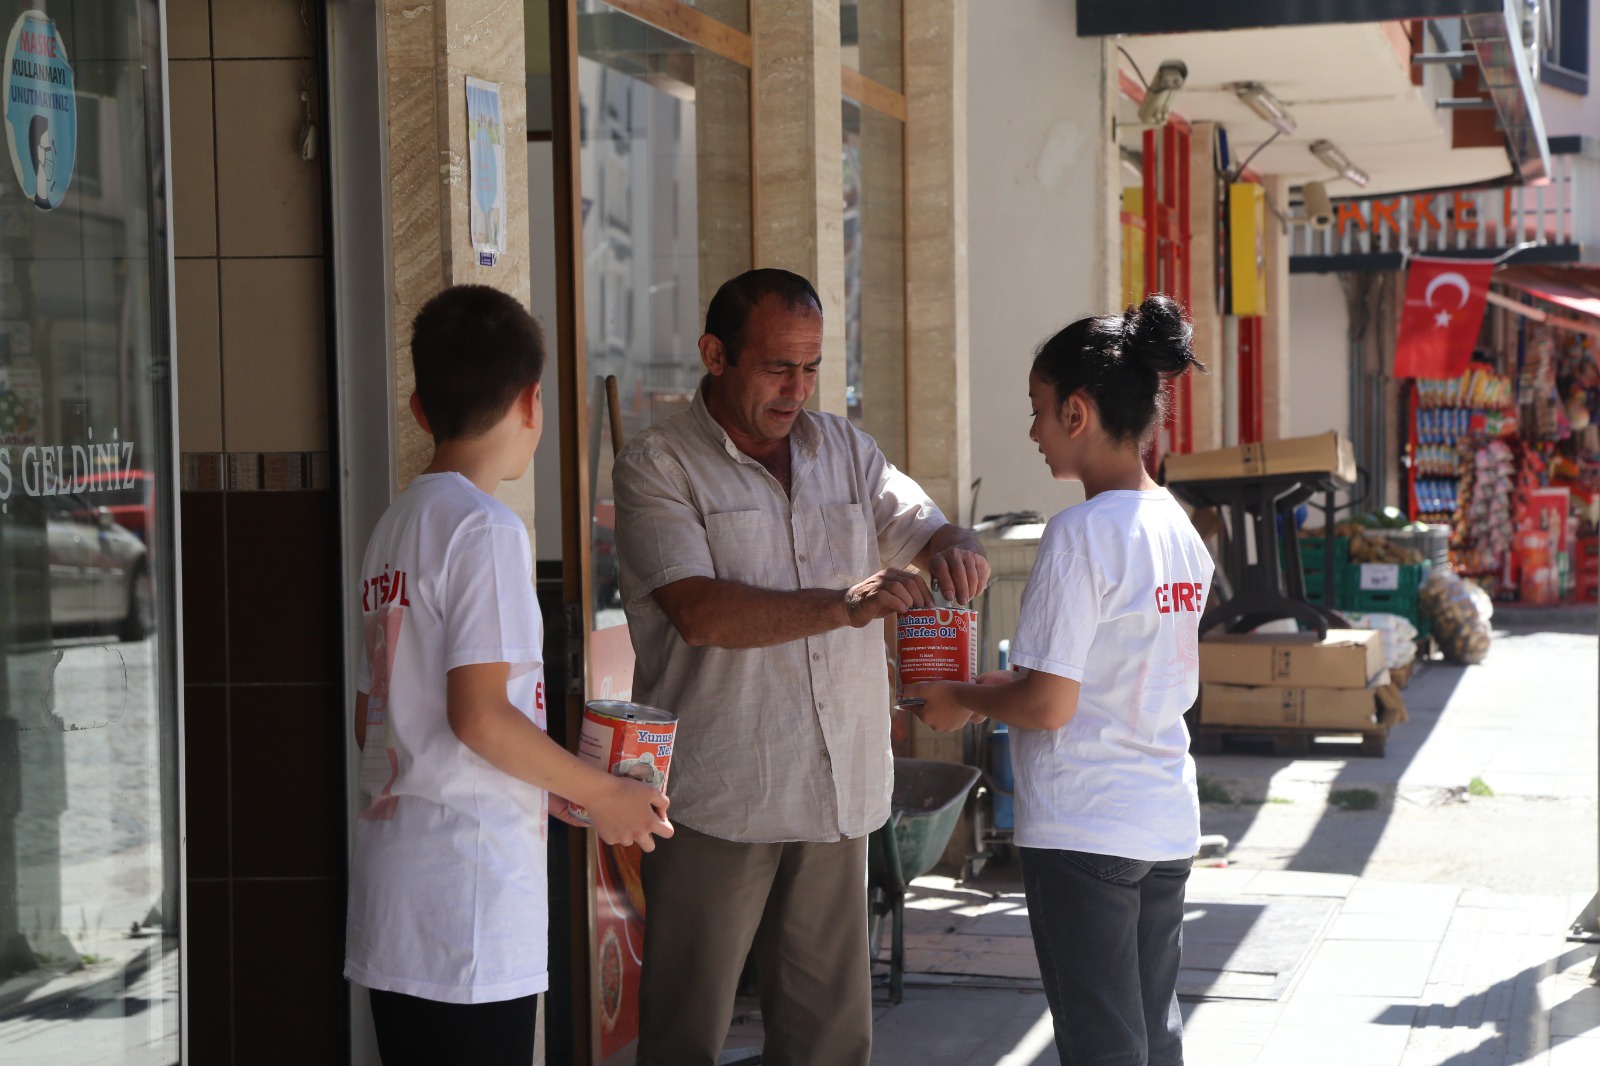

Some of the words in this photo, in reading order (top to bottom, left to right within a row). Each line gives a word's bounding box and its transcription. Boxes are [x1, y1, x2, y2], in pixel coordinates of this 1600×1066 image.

[19, 31, 57, 59] MASKE
[12, 58, 66, 85] KULLANMAYI
[11, 84, 69, 112] UNUTMAYINIZ
[21, 426, 136, 497] GELDİNİZ
[905, 627, 937, 639] Nefes
[939, 627, 957, 639] Ol!
[637, 730, 672, 744] Yunus
